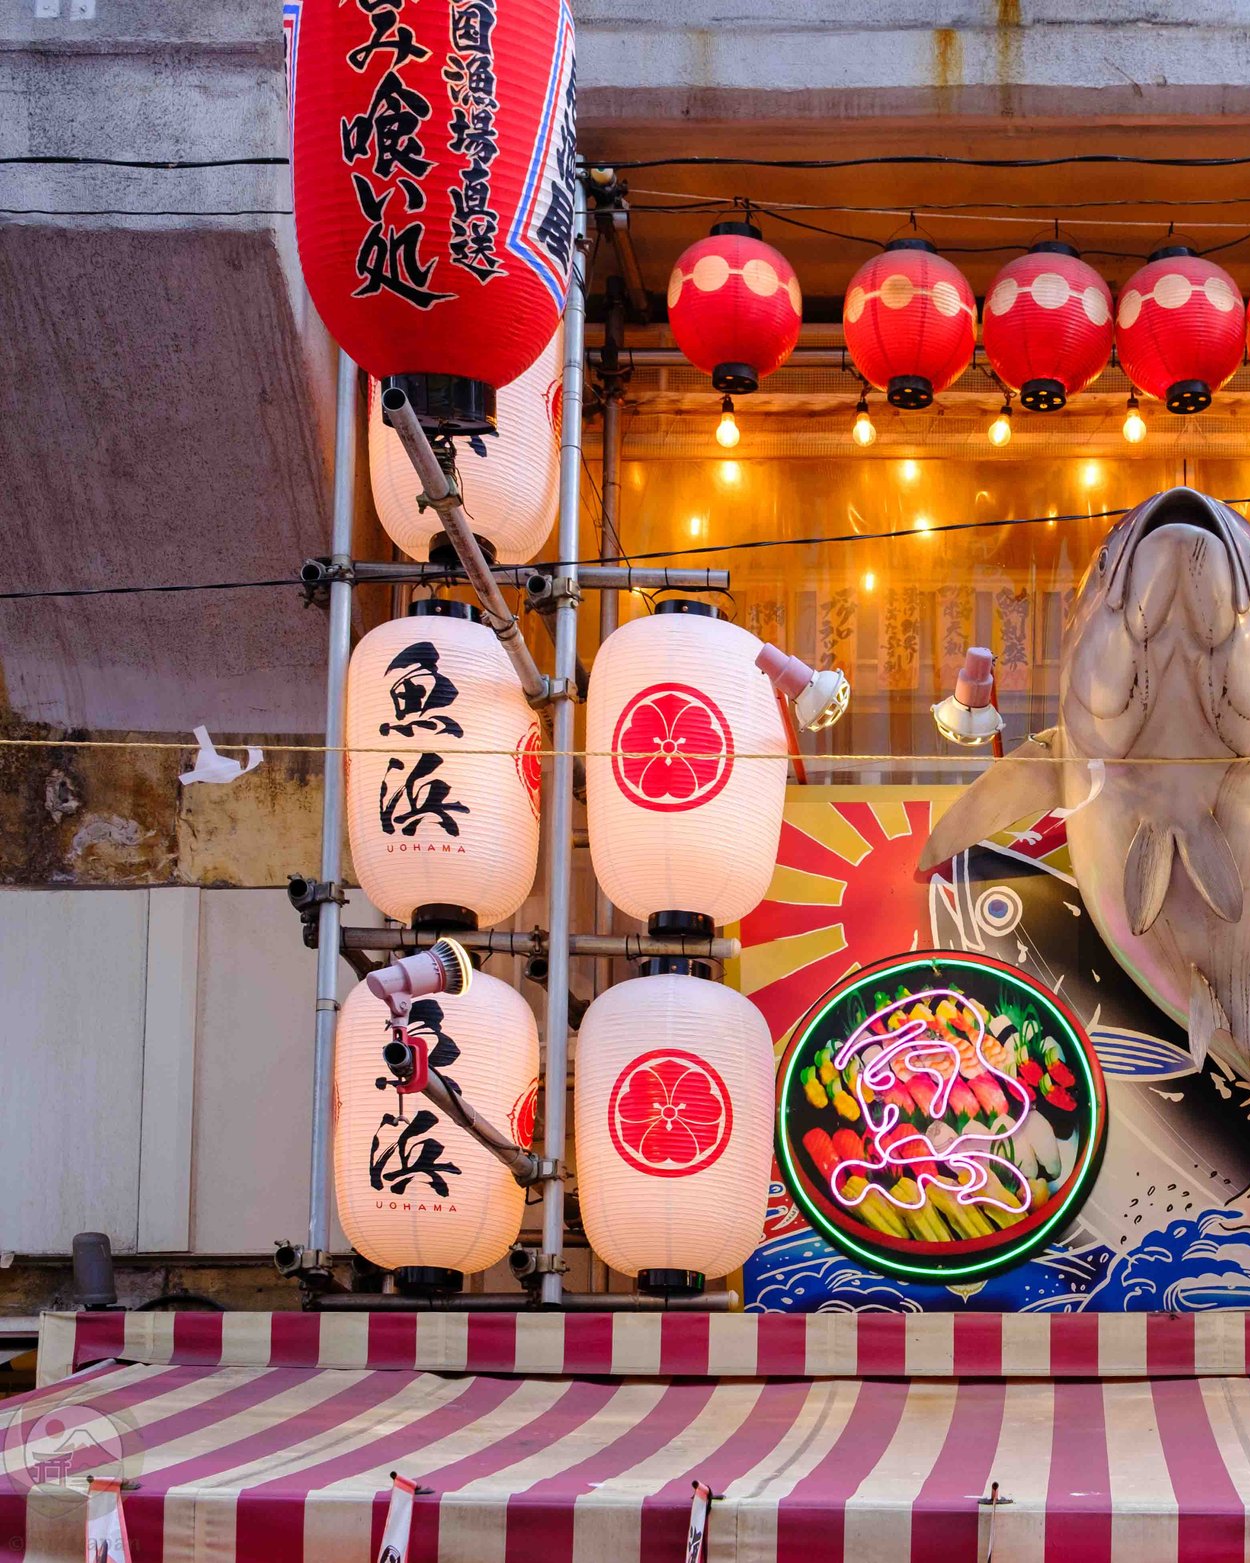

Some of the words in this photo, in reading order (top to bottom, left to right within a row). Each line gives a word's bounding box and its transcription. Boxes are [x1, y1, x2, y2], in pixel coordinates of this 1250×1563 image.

[442, 0, 508, 285] 国漁場直送
[379, 641, 470, 837] 魚浜
[386, 843, 467, 854] UOHAMA
[375, 1201, 457, 1213] UOHAMA
